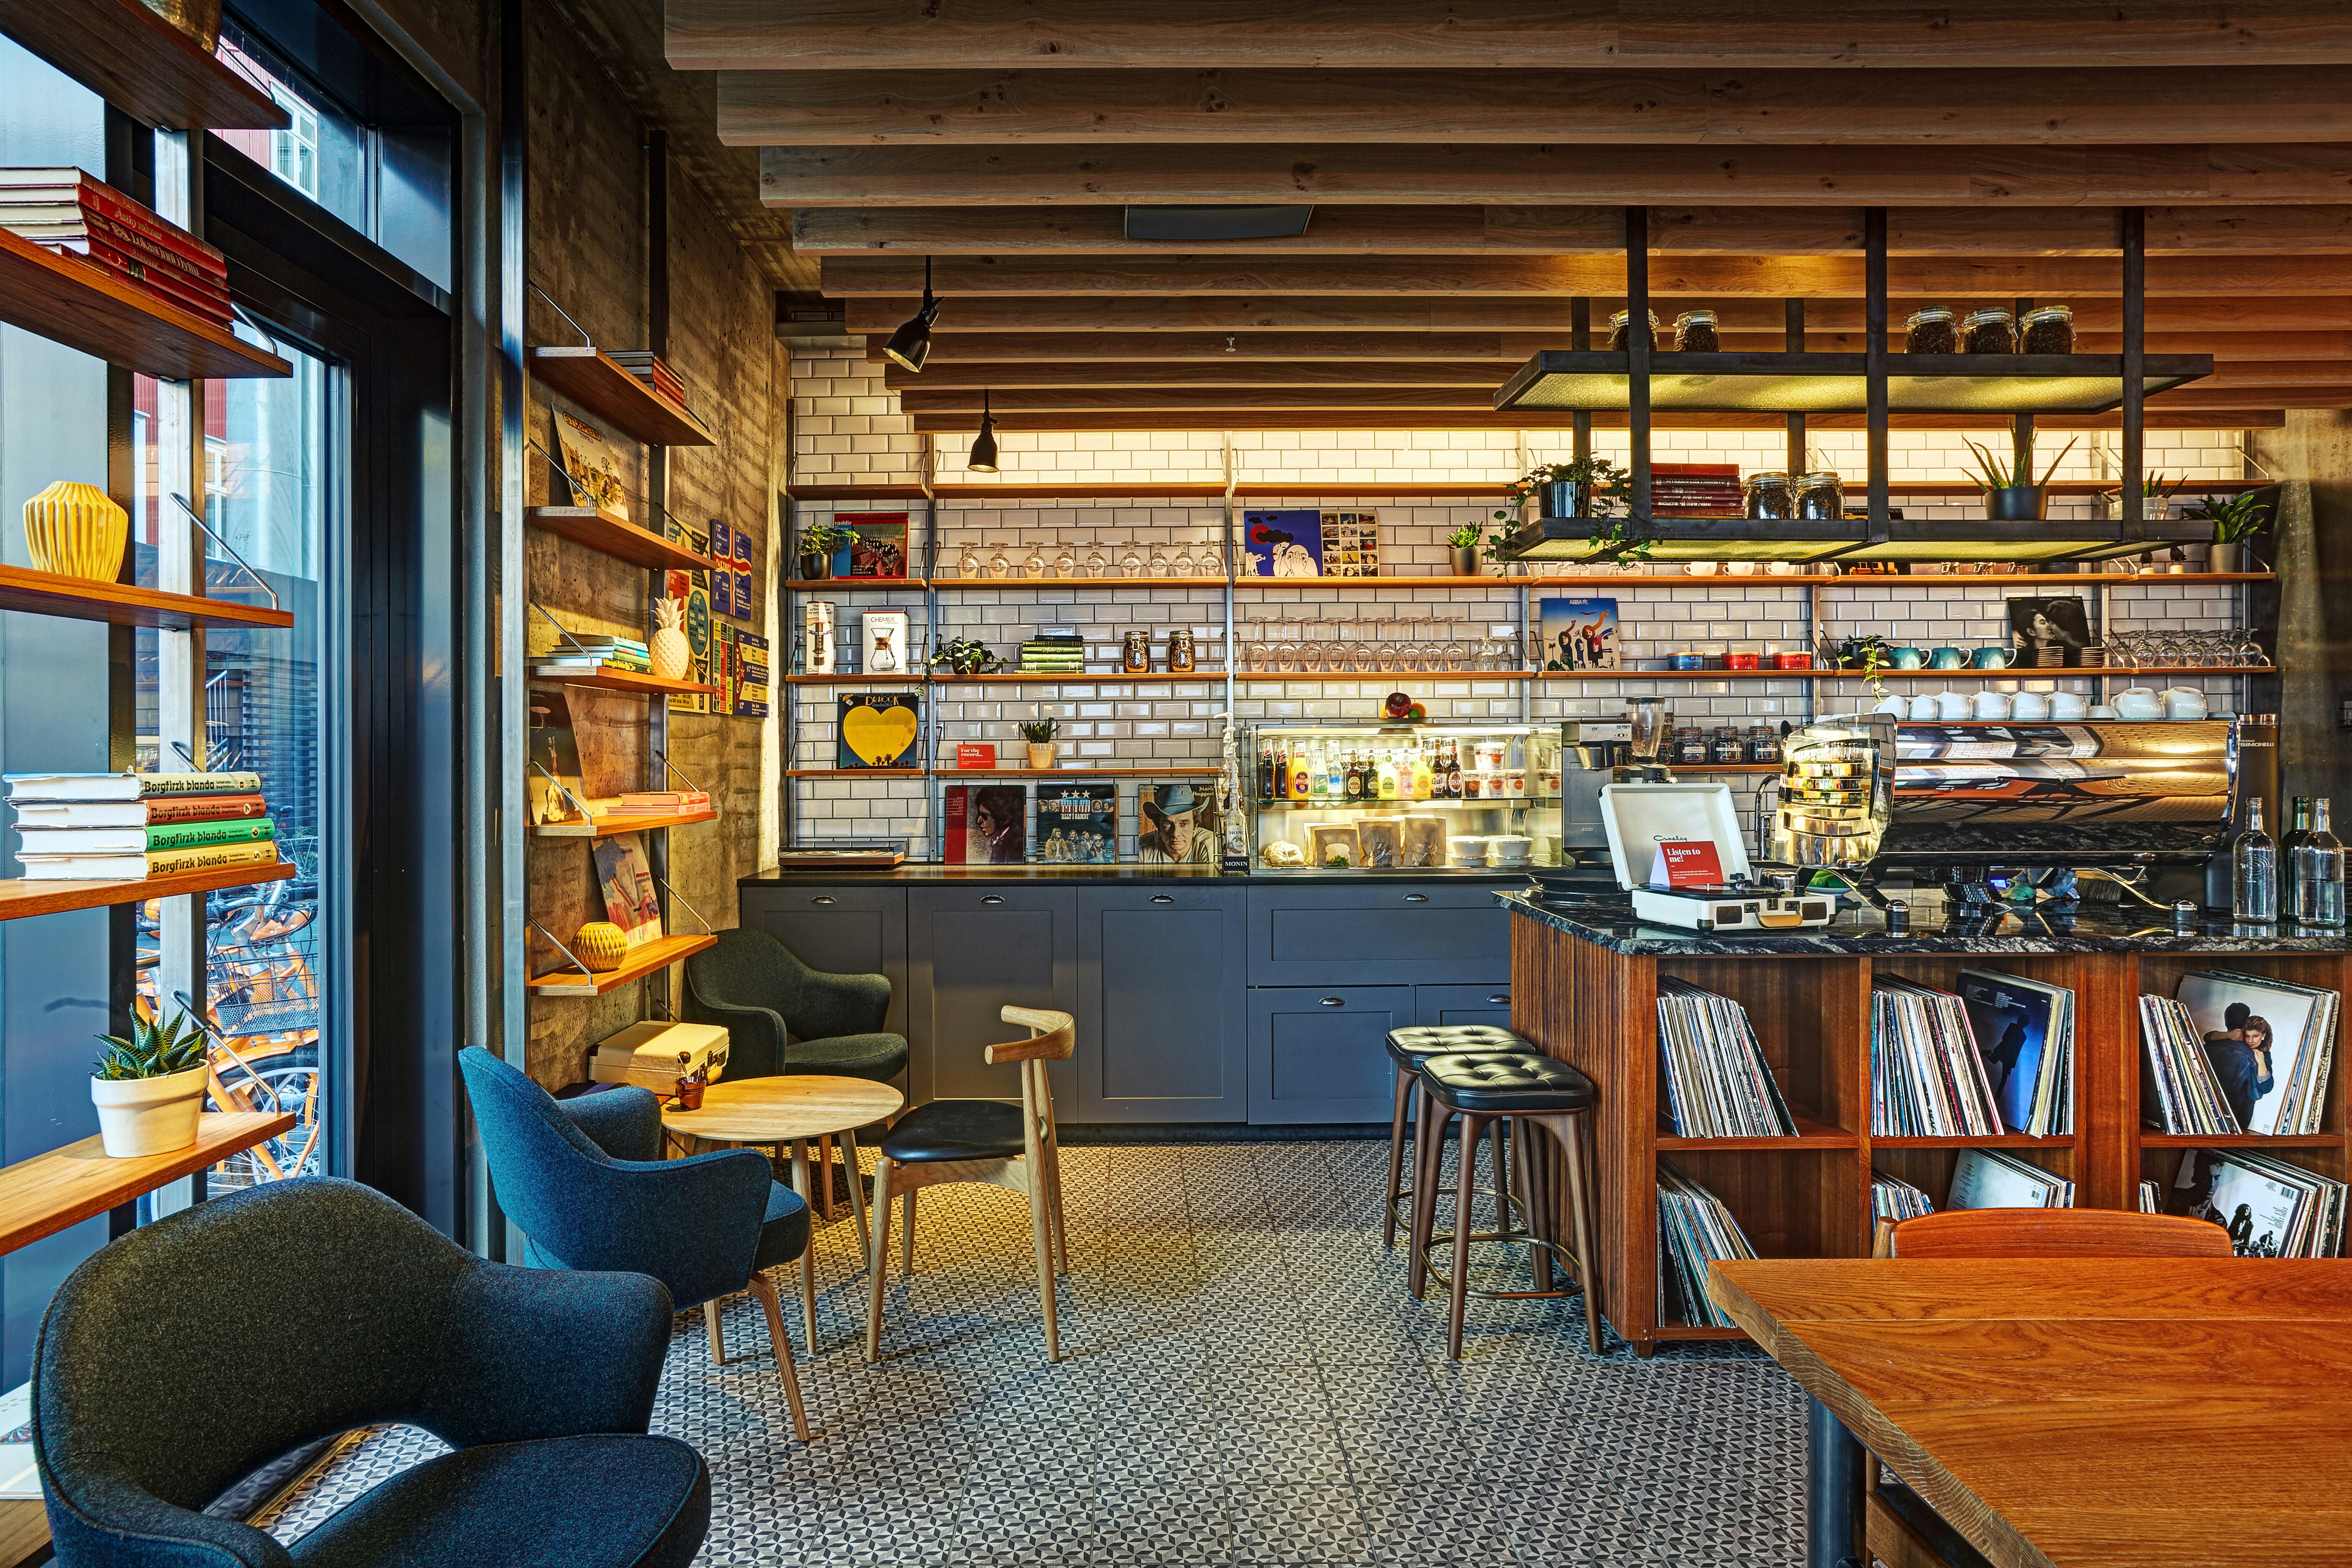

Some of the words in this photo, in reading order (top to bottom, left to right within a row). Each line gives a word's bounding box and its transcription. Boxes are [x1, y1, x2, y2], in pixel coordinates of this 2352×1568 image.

[131, 232, 159, 255] Lokast
[144, 780, 184, 794] Borgfirzk
[187, 780, 214, 791] blanda
[1432, 777, 1444, 785] Gull
[151, 806, 191, 820] Borgfirzk
[193, 805, 220, 816] blanda
[153, 832, 195, 847] Borgfirzk
[197, 830, 226, 841] blanda
[152, 858, 195, 874] Borgfirzk
[197, 854, 227, 867] blanda
